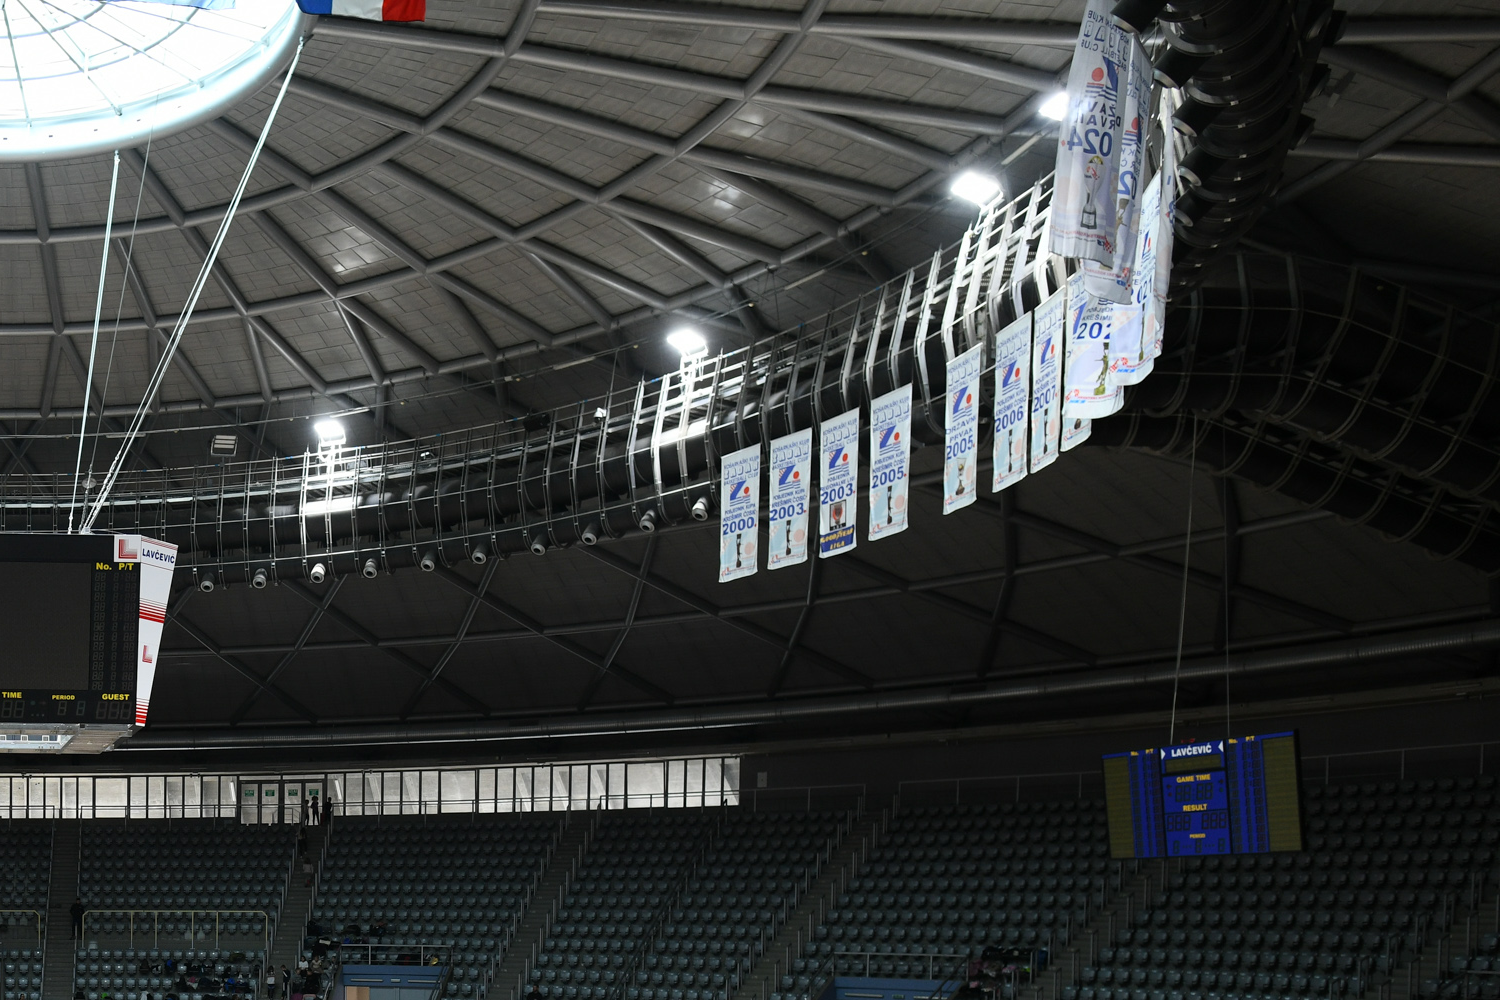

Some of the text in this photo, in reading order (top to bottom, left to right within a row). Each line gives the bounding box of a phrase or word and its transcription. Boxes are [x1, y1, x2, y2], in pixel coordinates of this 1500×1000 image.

[142, 548, 175, 564] LAVČEVIĆ
[96, 562, 134, 571] No. P/T
[1, 691, 23, 699] TIME
[1171, 742, 1212, 758] LAVČEVIĆ
[1176, 773, 1211, 783] GAME TIME
[1183, 803, 1208, 812] RESULT
